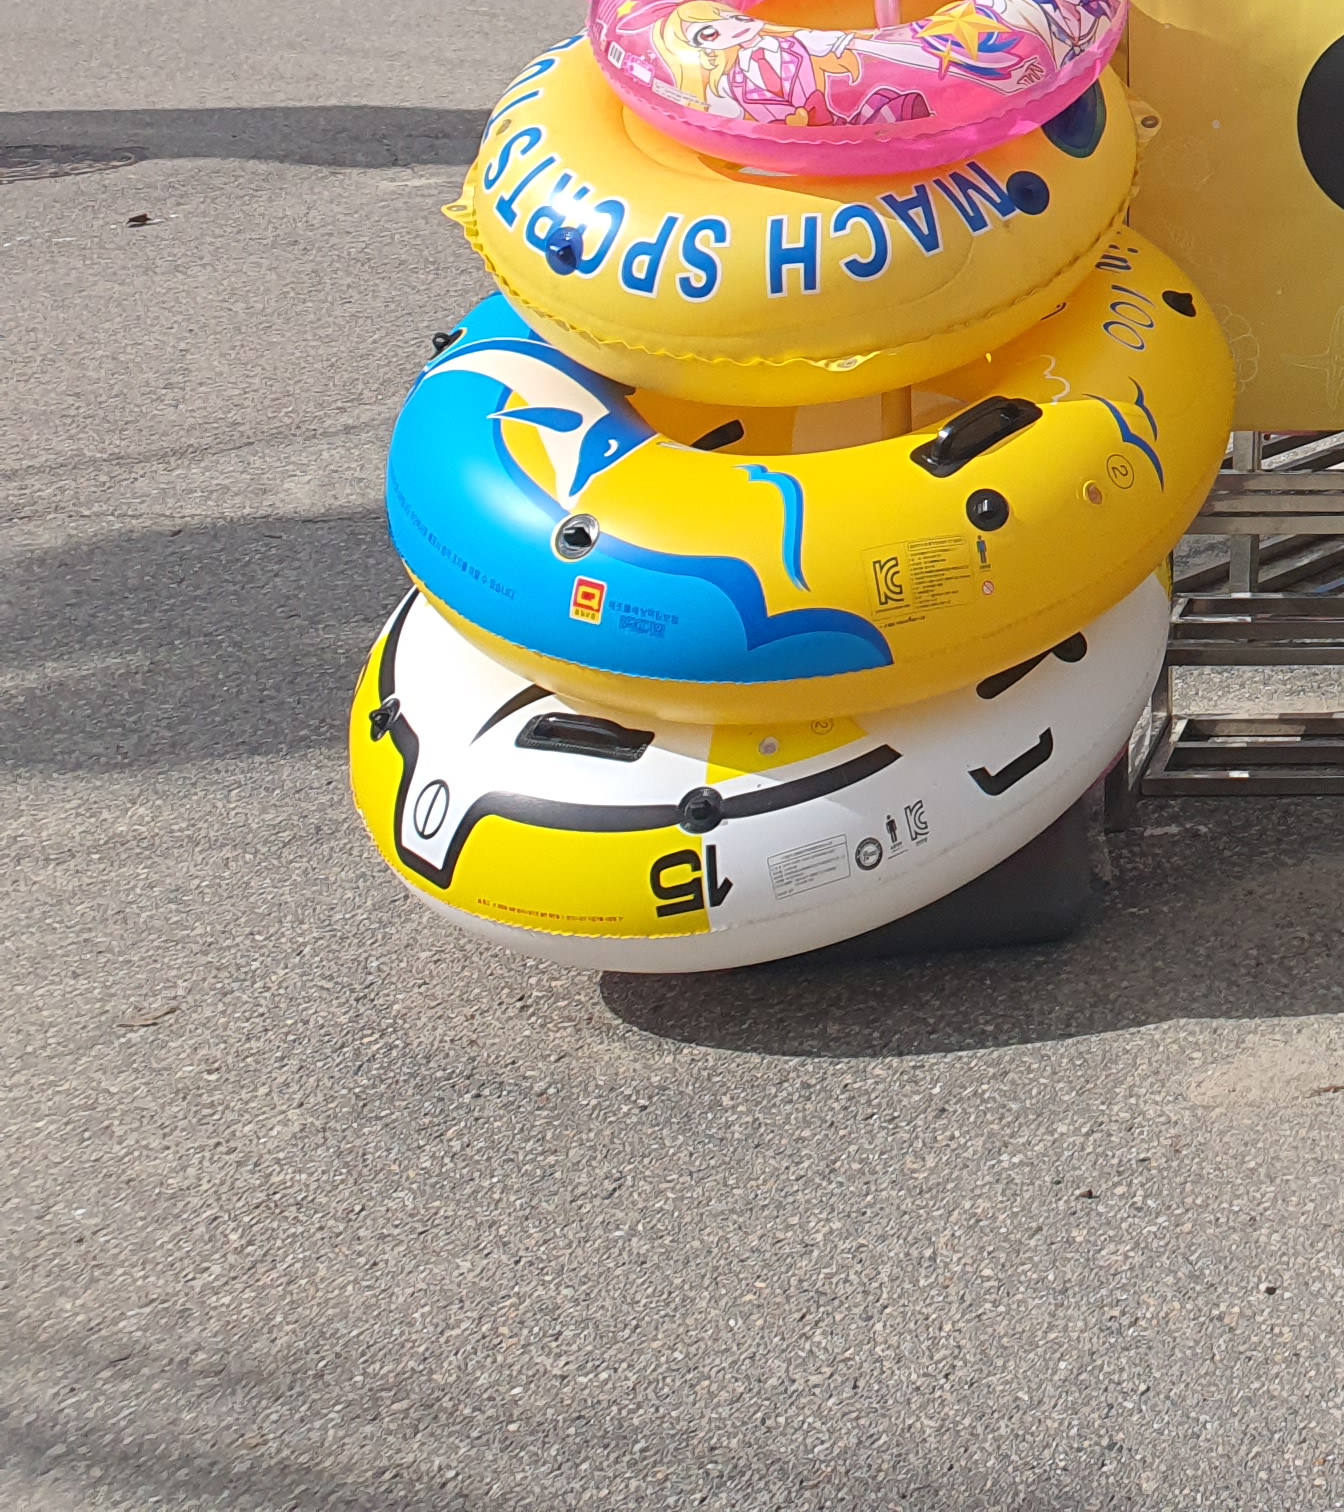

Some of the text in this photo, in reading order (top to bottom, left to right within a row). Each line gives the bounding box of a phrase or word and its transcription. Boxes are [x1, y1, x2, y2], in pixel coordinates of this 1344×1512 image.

[482, 124, 1014, 303] MACH SPORTS
[1102, 284, 1156, 351] 100
[649, 844, 733, 918] 15
